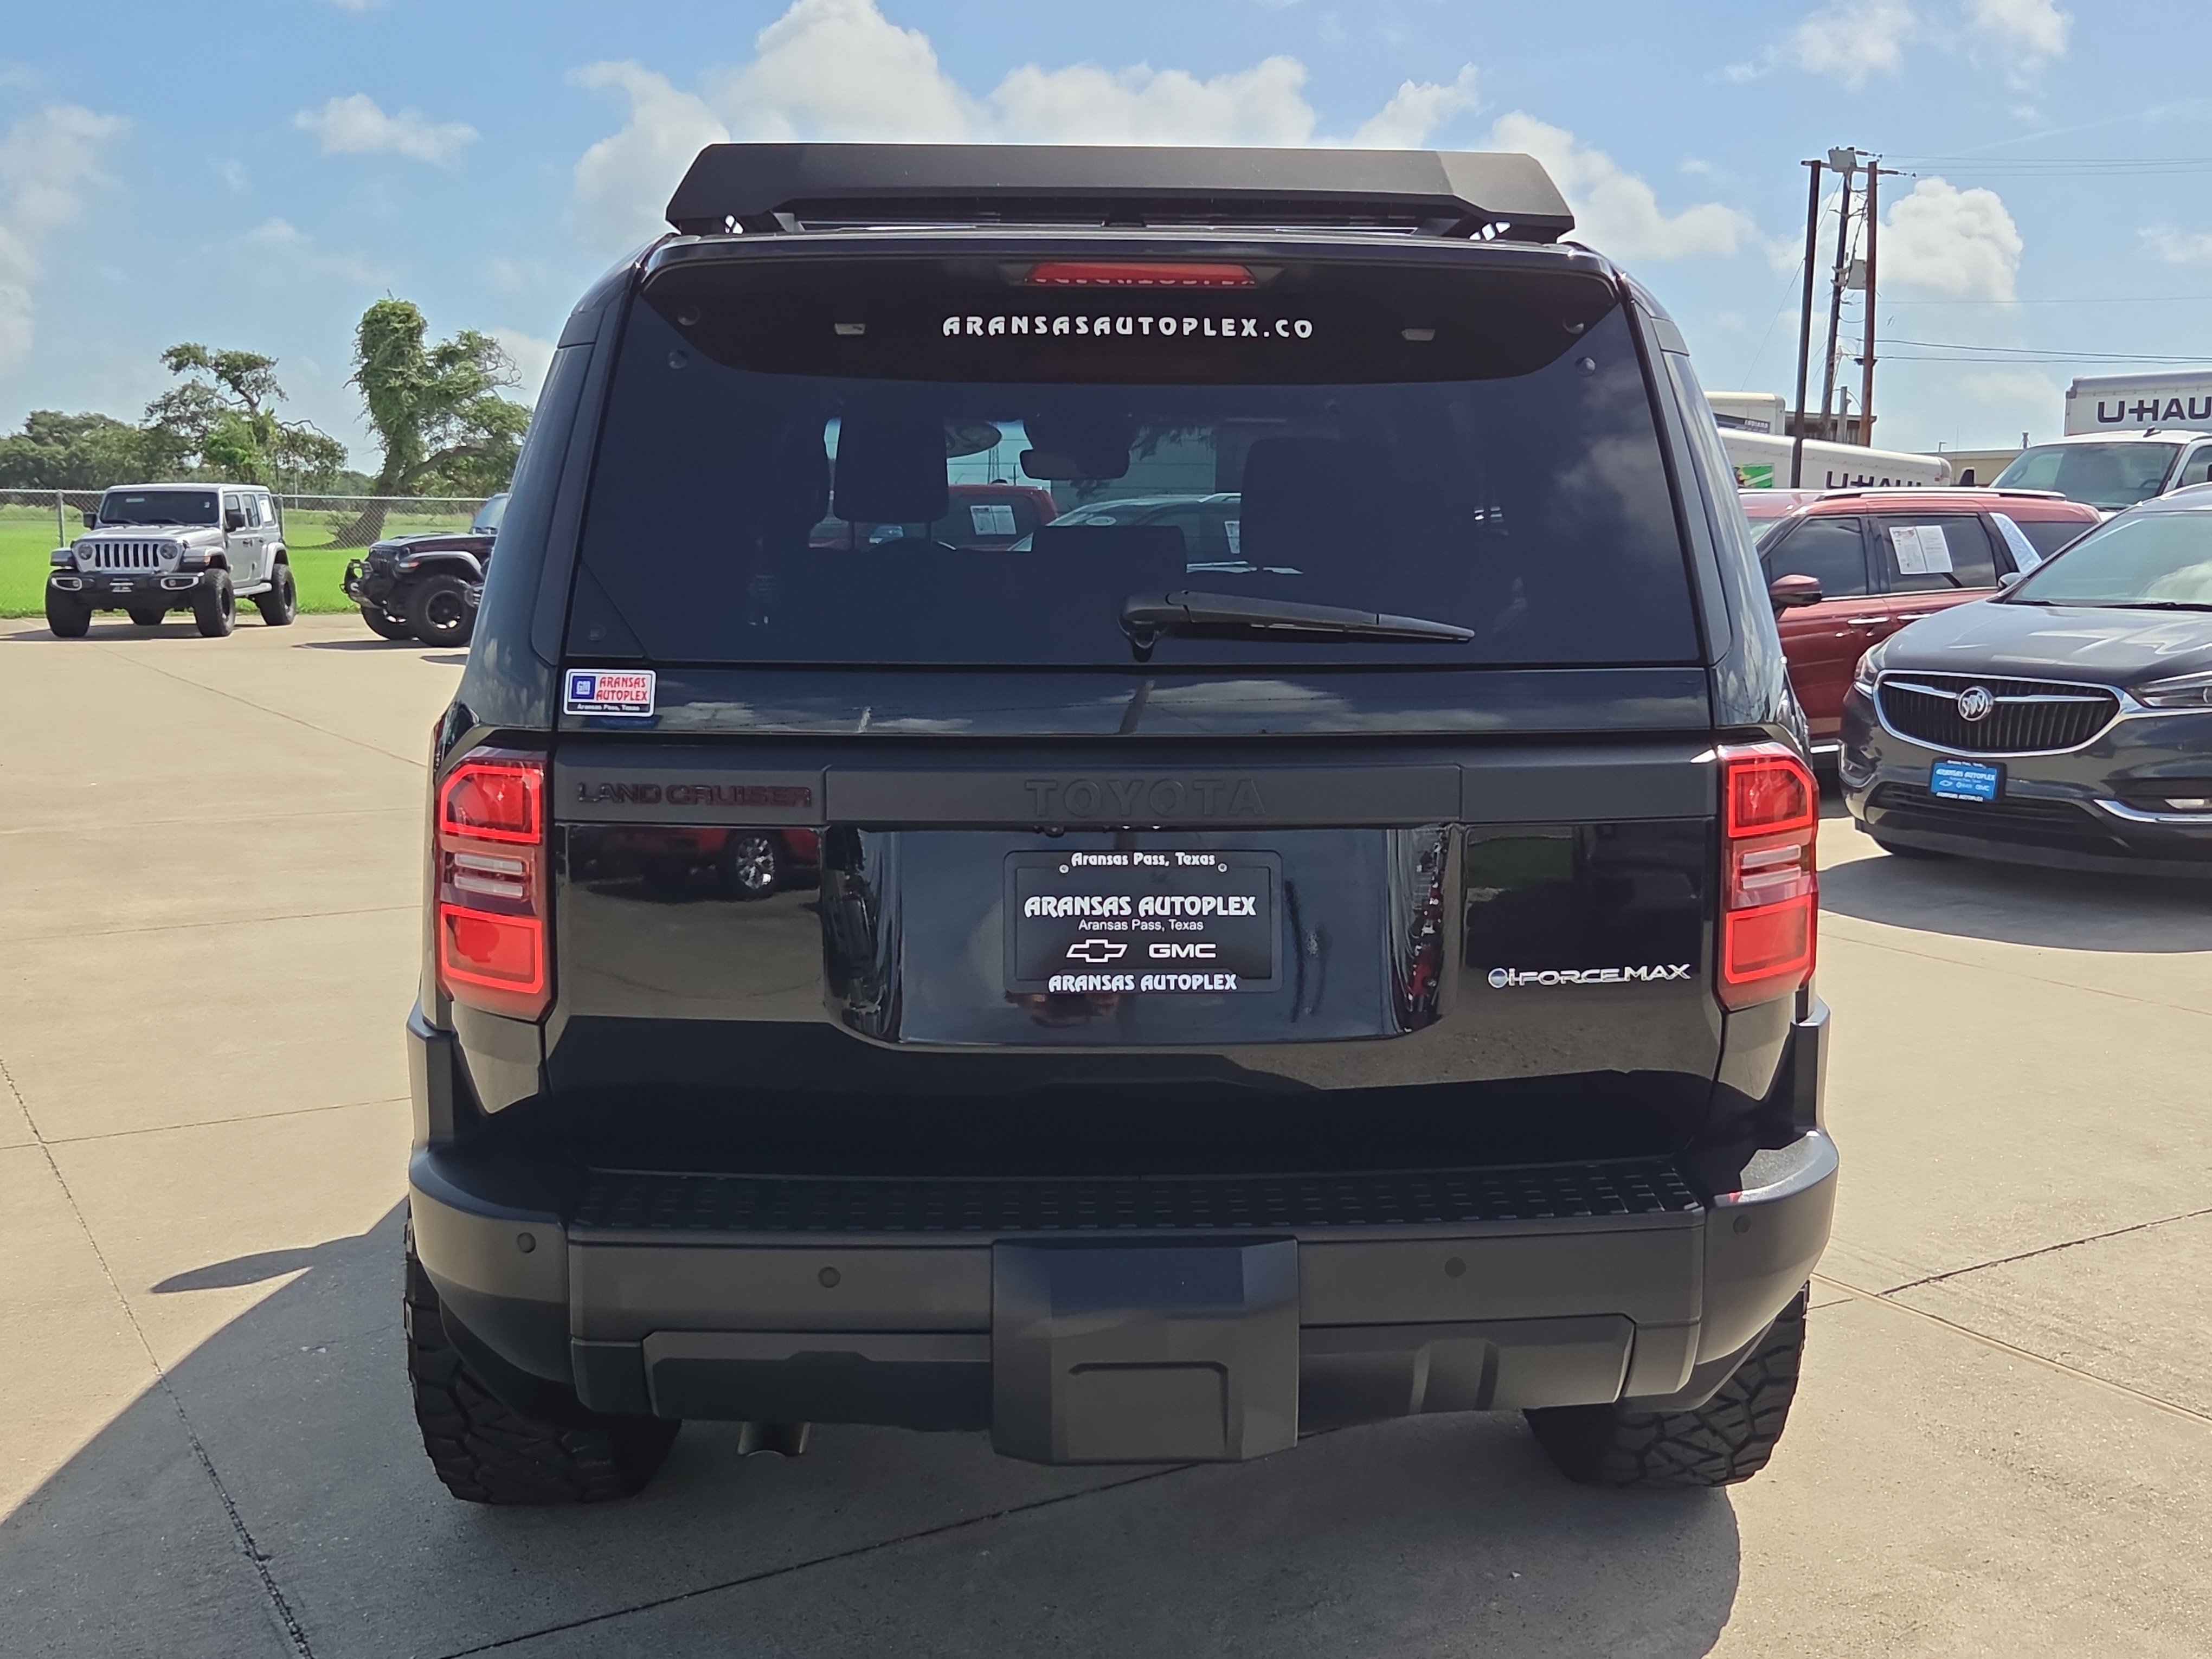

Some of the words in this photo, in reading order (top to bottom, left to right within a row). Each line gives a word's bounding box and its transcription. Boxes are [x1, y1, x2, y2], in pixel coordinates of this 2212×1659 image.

[942, 316, 1313, 338] ARANSASAUTOPLEX.CO
[599, 676, 646, 688] ARANSAS
[596, 690, 648, 701] AUTOPLEX
[577, 782, 662, 803] LAND
[666, 784, 812, 807] CRUISER
[1025, 779, 1266, 818] TOYOTA
[1071, 852, 1129, 867] Aransas
[1133, 852, 1170, 867] Pass,
[1175, 852, 1216, 866] Texas
[1024, 896, 1133, 918] ARANSAS
[1138, 896, 1257, 917] AUTOPLEX
[1078, 919, 1128, 931] Aransas
[1131, 919, 1166, 932] Pass,
[1168, 919, 1204, 931] Texas
[1148, 943, 1217, 959] GMC
[1048, 974, 1135, 993] ARANSAS
[1140, 974, 1238, 993] AUTOPLEX
